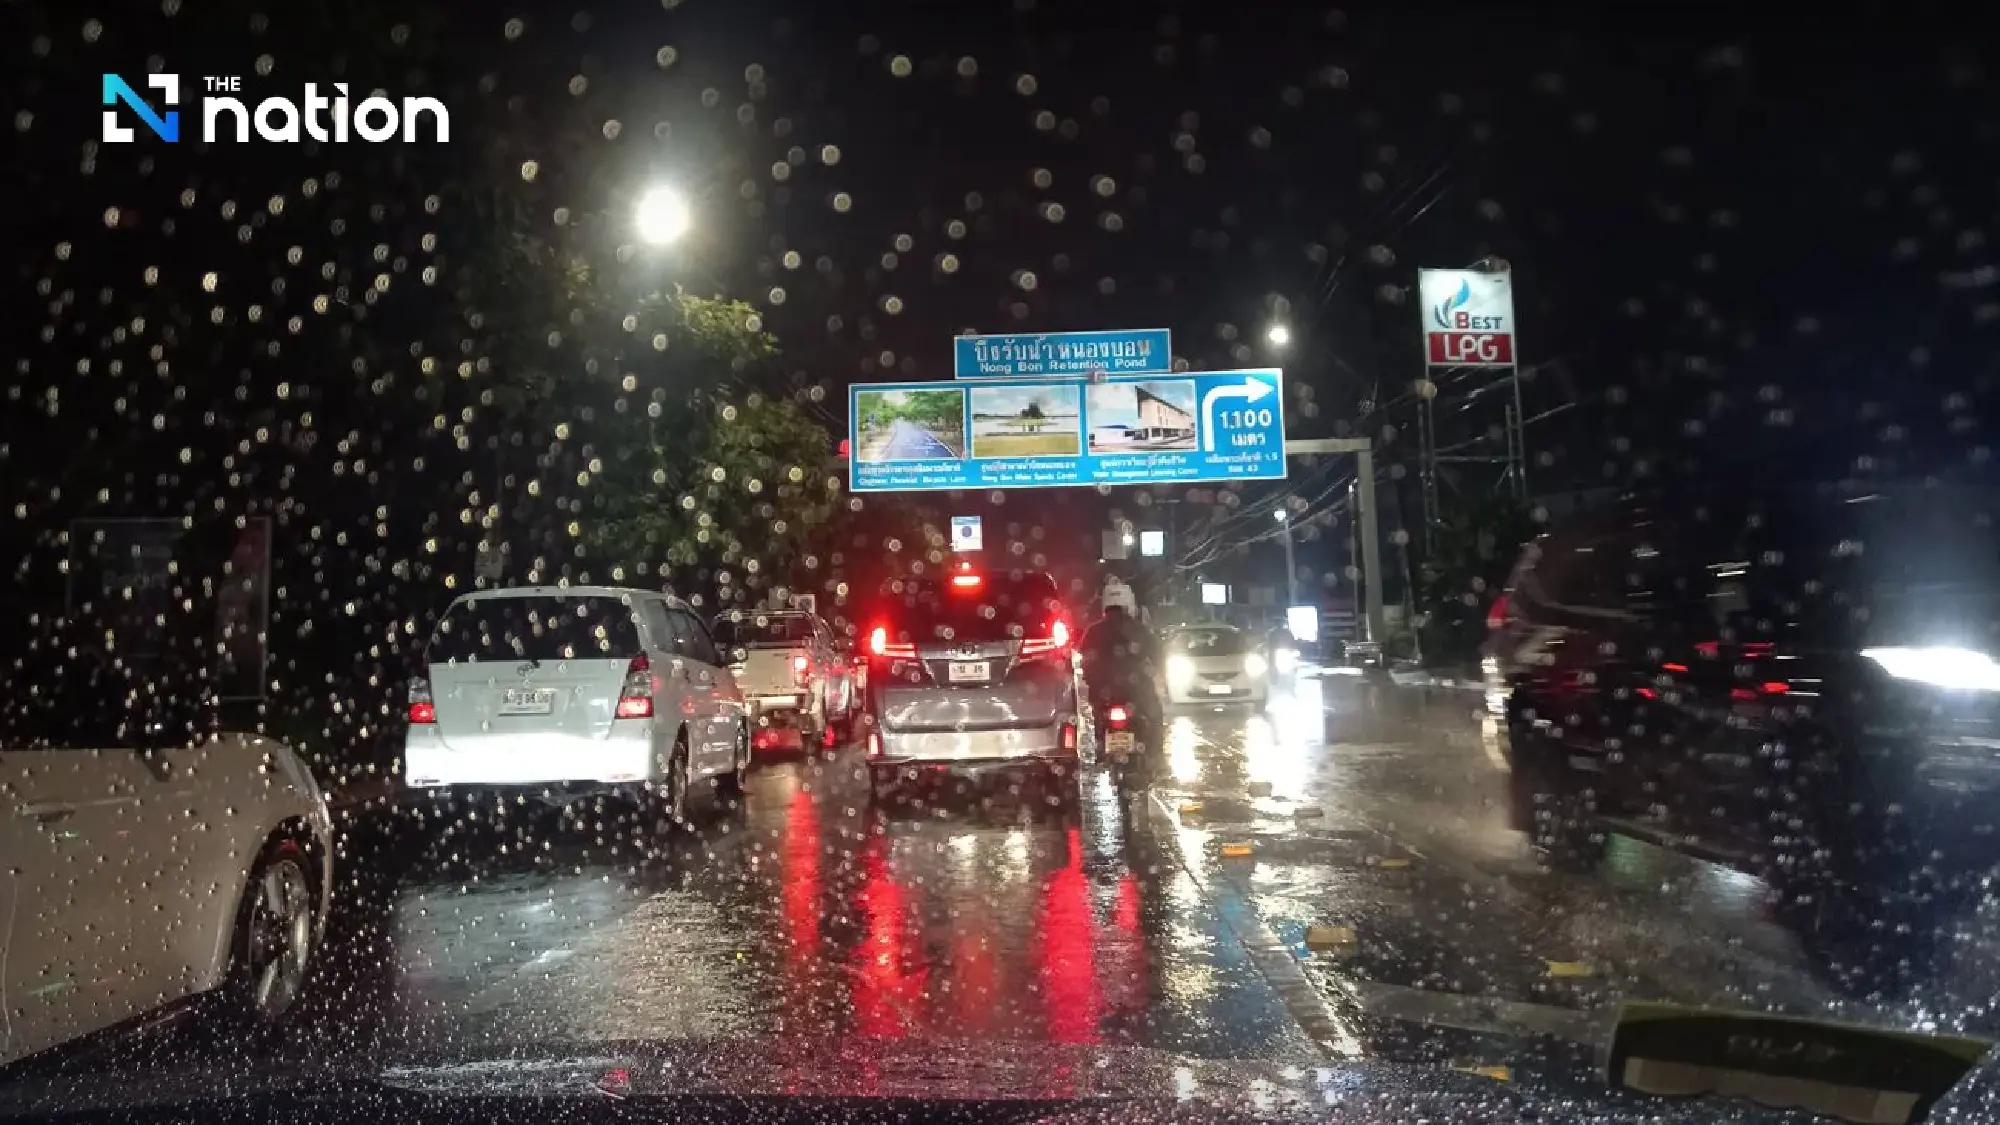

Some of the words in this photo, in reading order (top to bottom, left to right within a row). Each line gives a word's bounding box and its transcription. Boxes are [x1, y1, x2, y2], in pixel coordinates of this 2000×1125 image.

[1444, 335, 1498, 361] LPG
[980, 362, 1011, 374] Nong
[1017, 361, 1043, 372] Bon
[1050, 357, 1109, 370] Retention
[1114, 357, 1147, 368] Pond
